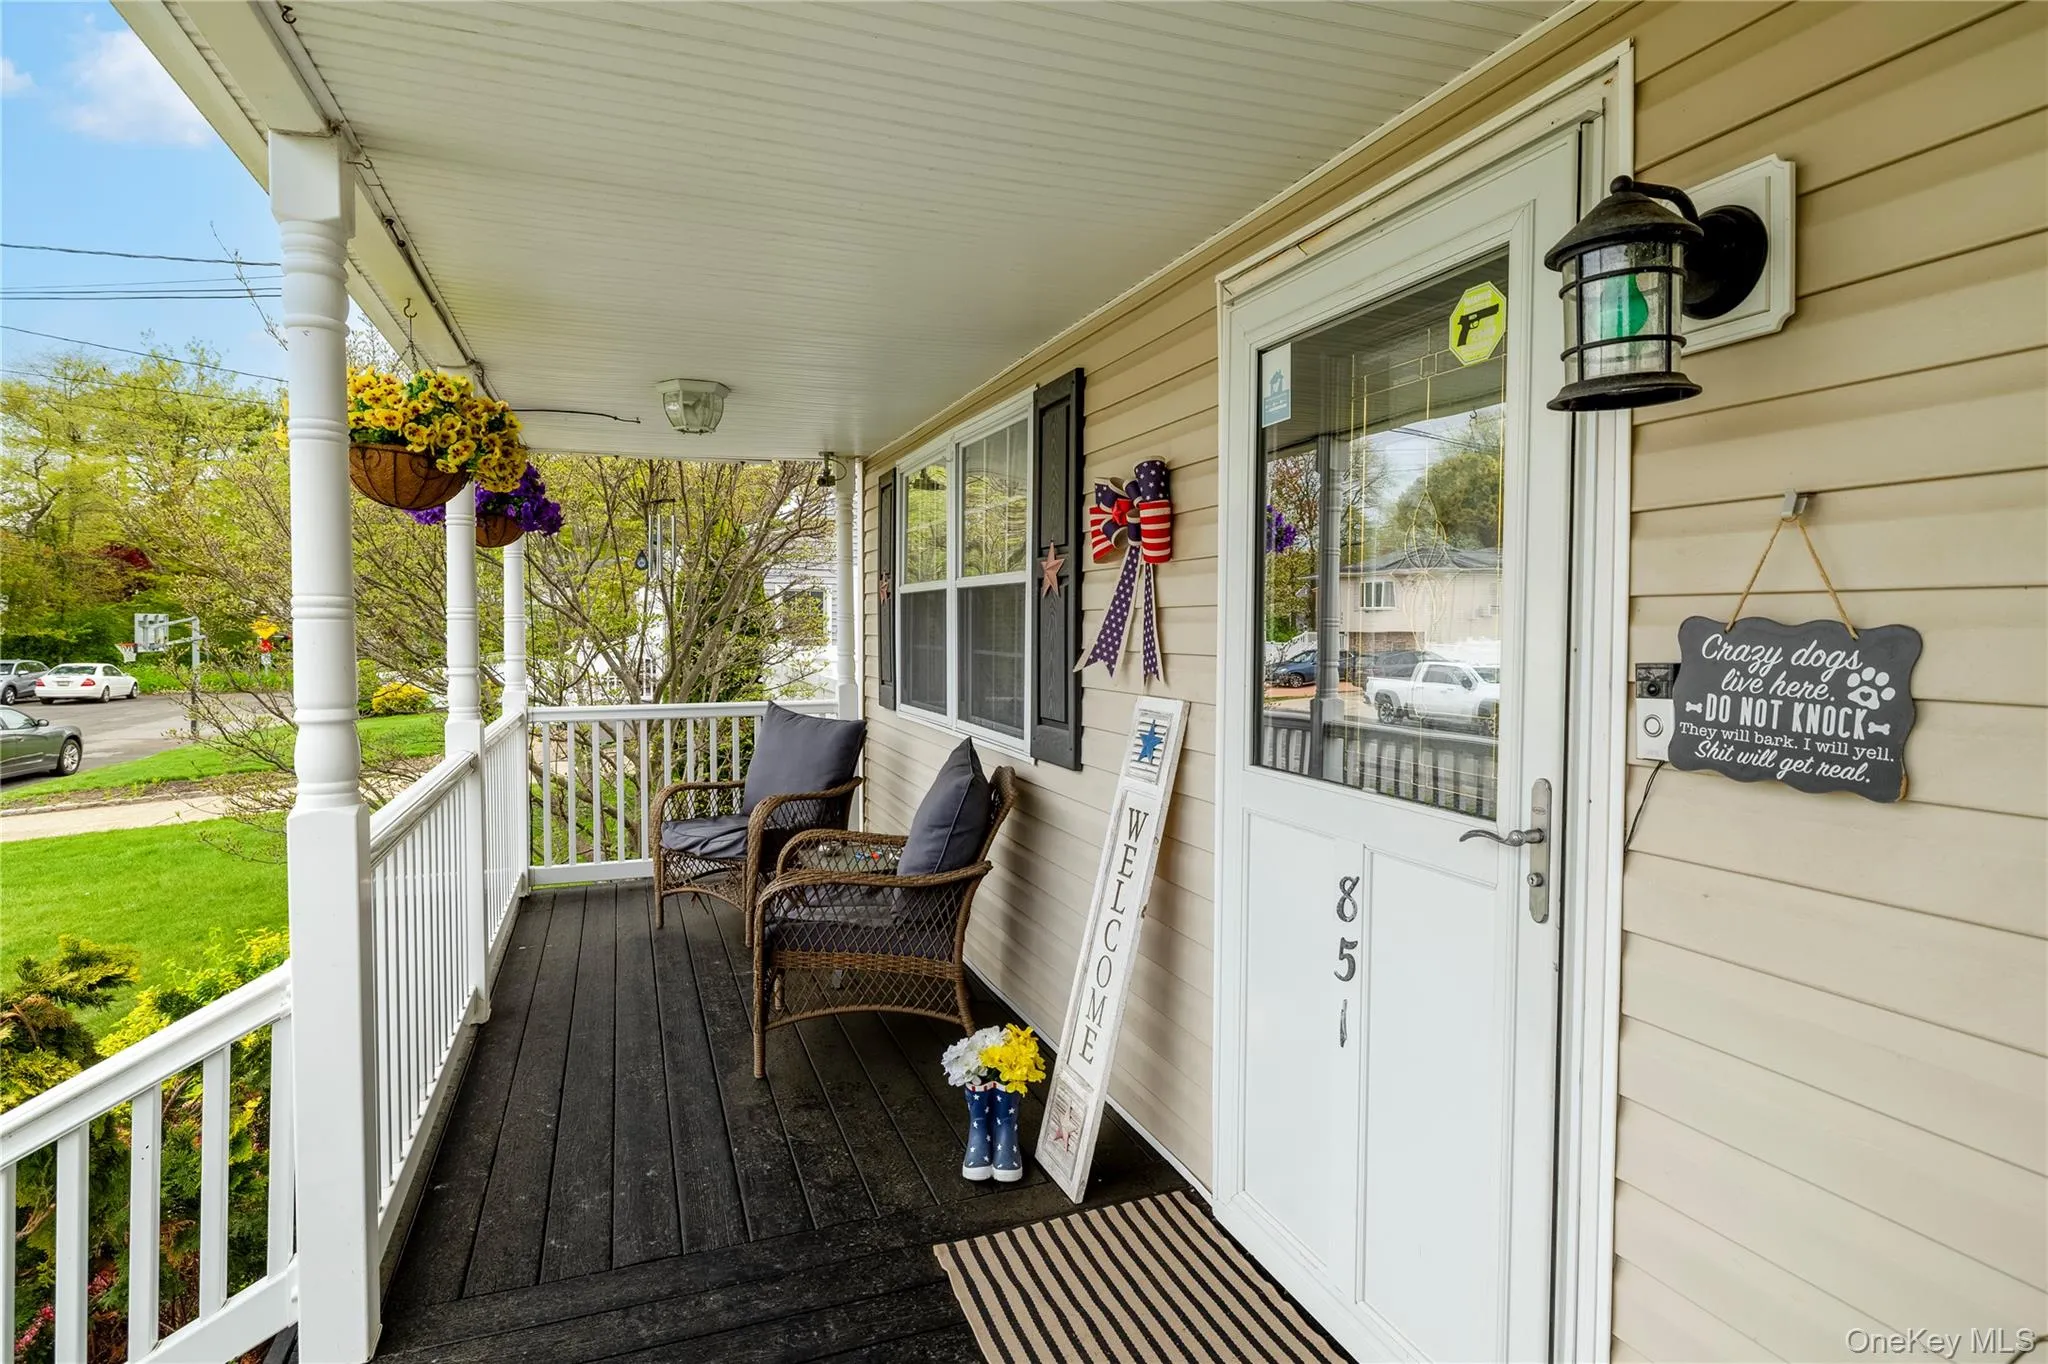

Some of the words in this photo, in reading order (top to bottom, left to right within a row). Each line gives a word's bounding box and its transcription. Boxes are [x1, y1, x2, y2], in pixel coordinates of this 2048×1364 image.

[1701, 633, 1783, 677] Crazy
[1790, 639, 1863, 682] dogs
[1721, 668, 1764, 694] live
[1769, 670, 1835, 701] here.
[1705, 693, 1730, 722] DO
[1740, 697, 1783, 730] NOT
[1792, 702, 1868, 740] KNOCK
[1679, 721, 1717, 739] They
[1721, 727, 1750, 743] will
[1754, 731, 1798, 750] bark.
[1803, 738, 1811, 750] I
[1815, 740, 1849, 756] will
[1853, 744, 1895, 762] yell.
[1694, 740, 1733, 762] Shit
[1737, 747, 1776, 768] will
[1776, 755, 1812, 780] get
[1815, 761, 1871, 783] real.
[1078, 807, 1149, 1064] WELCOME
